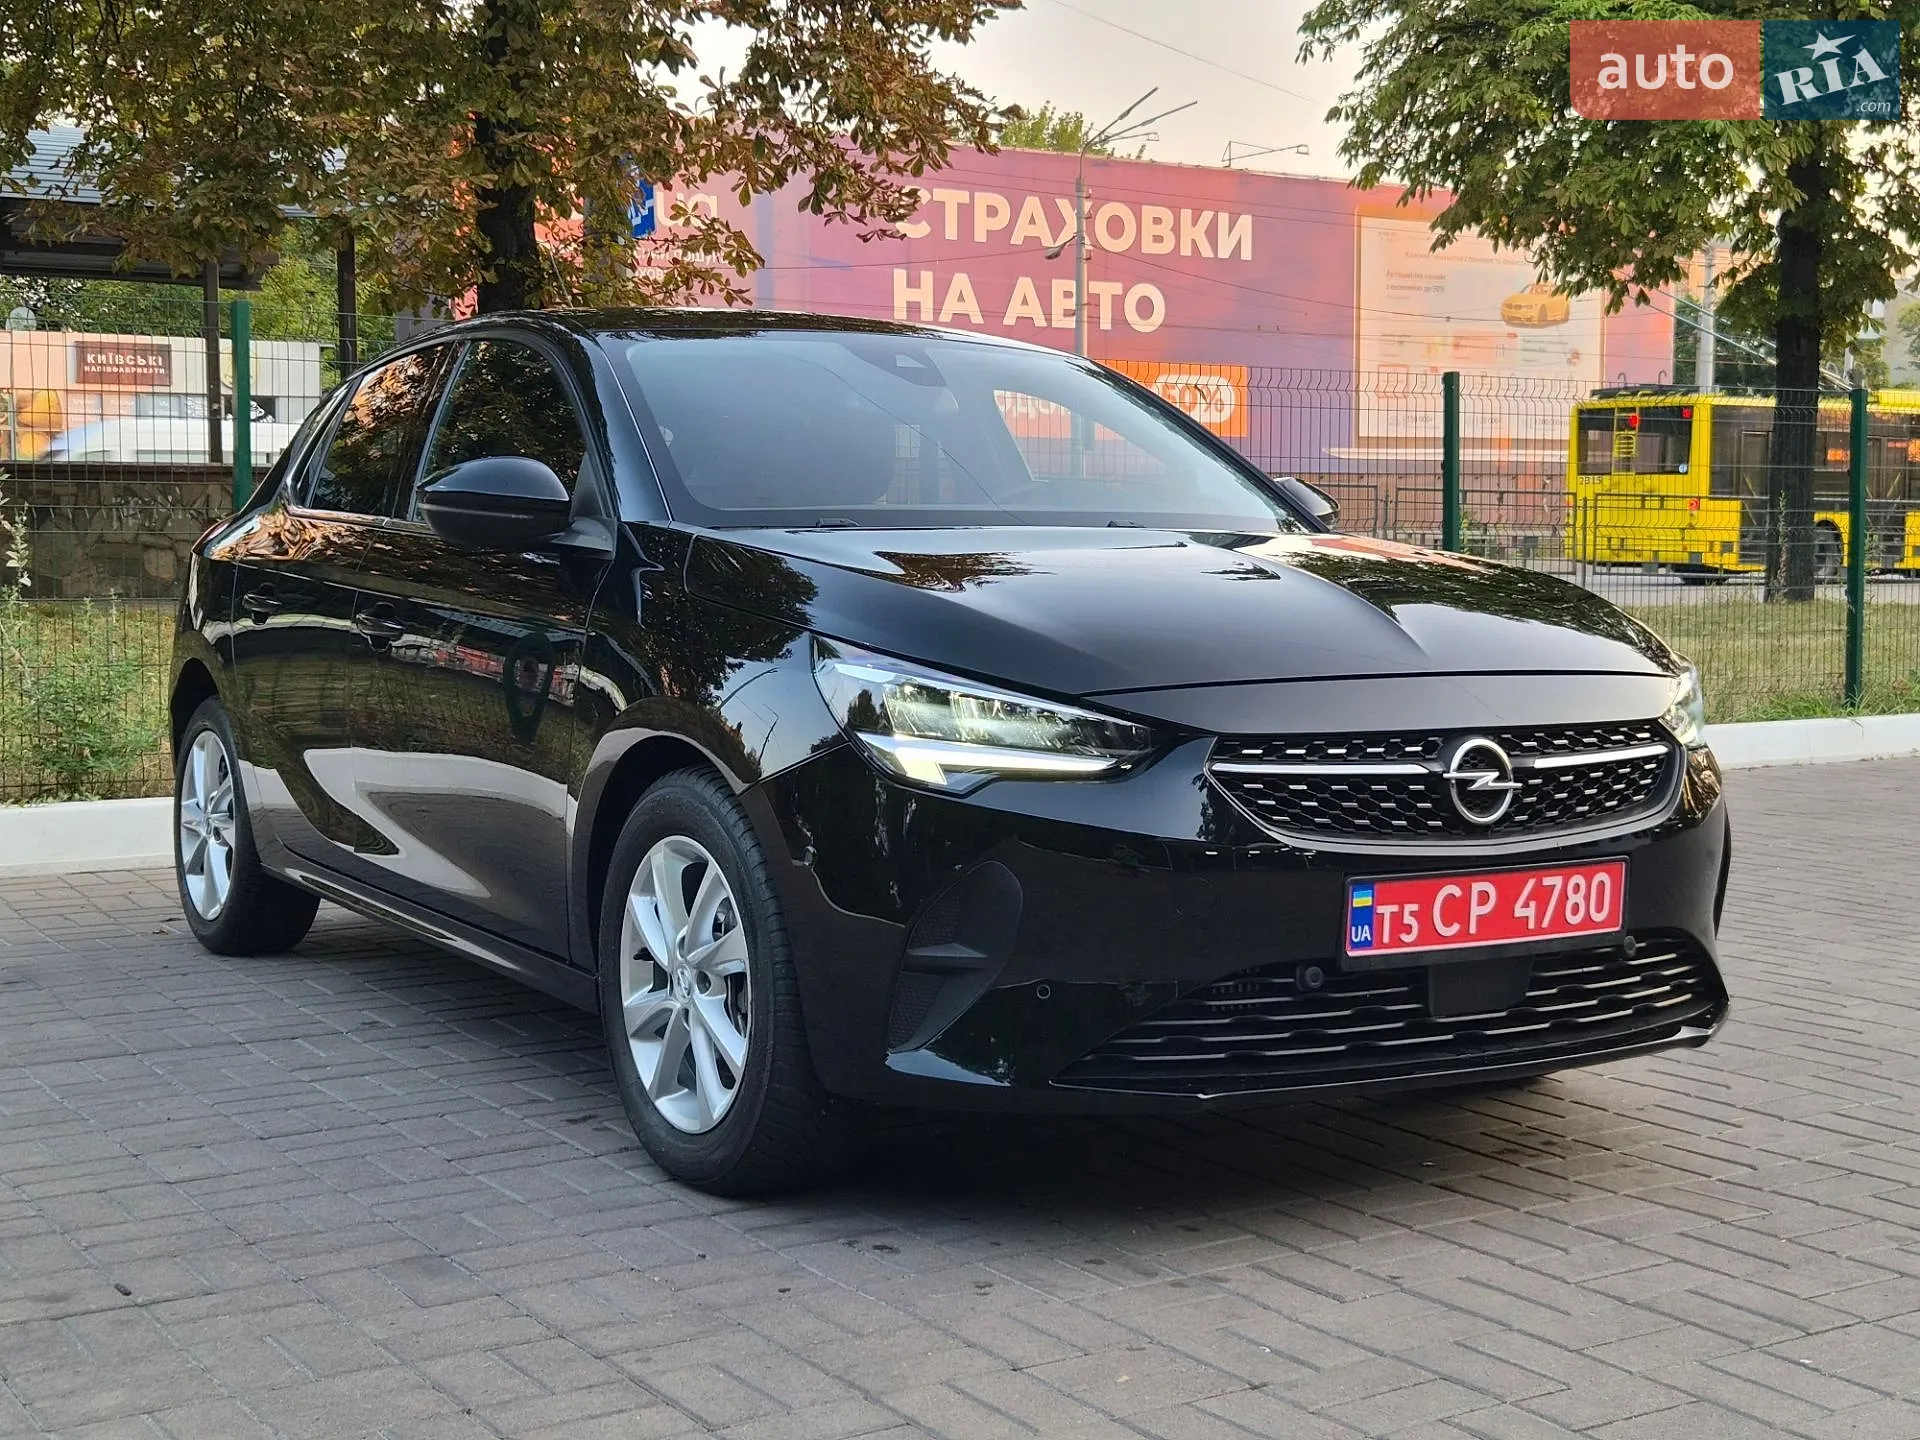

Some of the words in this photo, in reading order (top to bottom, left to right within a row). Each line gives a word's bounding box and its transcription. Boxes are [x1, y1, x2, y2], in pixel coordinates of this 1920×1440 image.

[894, 186, 1253, 261] СТРАХОВКИ
[893, 268, 984, 325] НА
[1002, 276, 1166, 333] АВТО
[86, 352, 163, 366] КИЇВСЬКІ
[1351, 924, 1372, 943] UA
[1376, 903, 1419, 944] T5
[1432, 881, 1497, 937] CP
[1513, 872, 1612, 930] 4780
